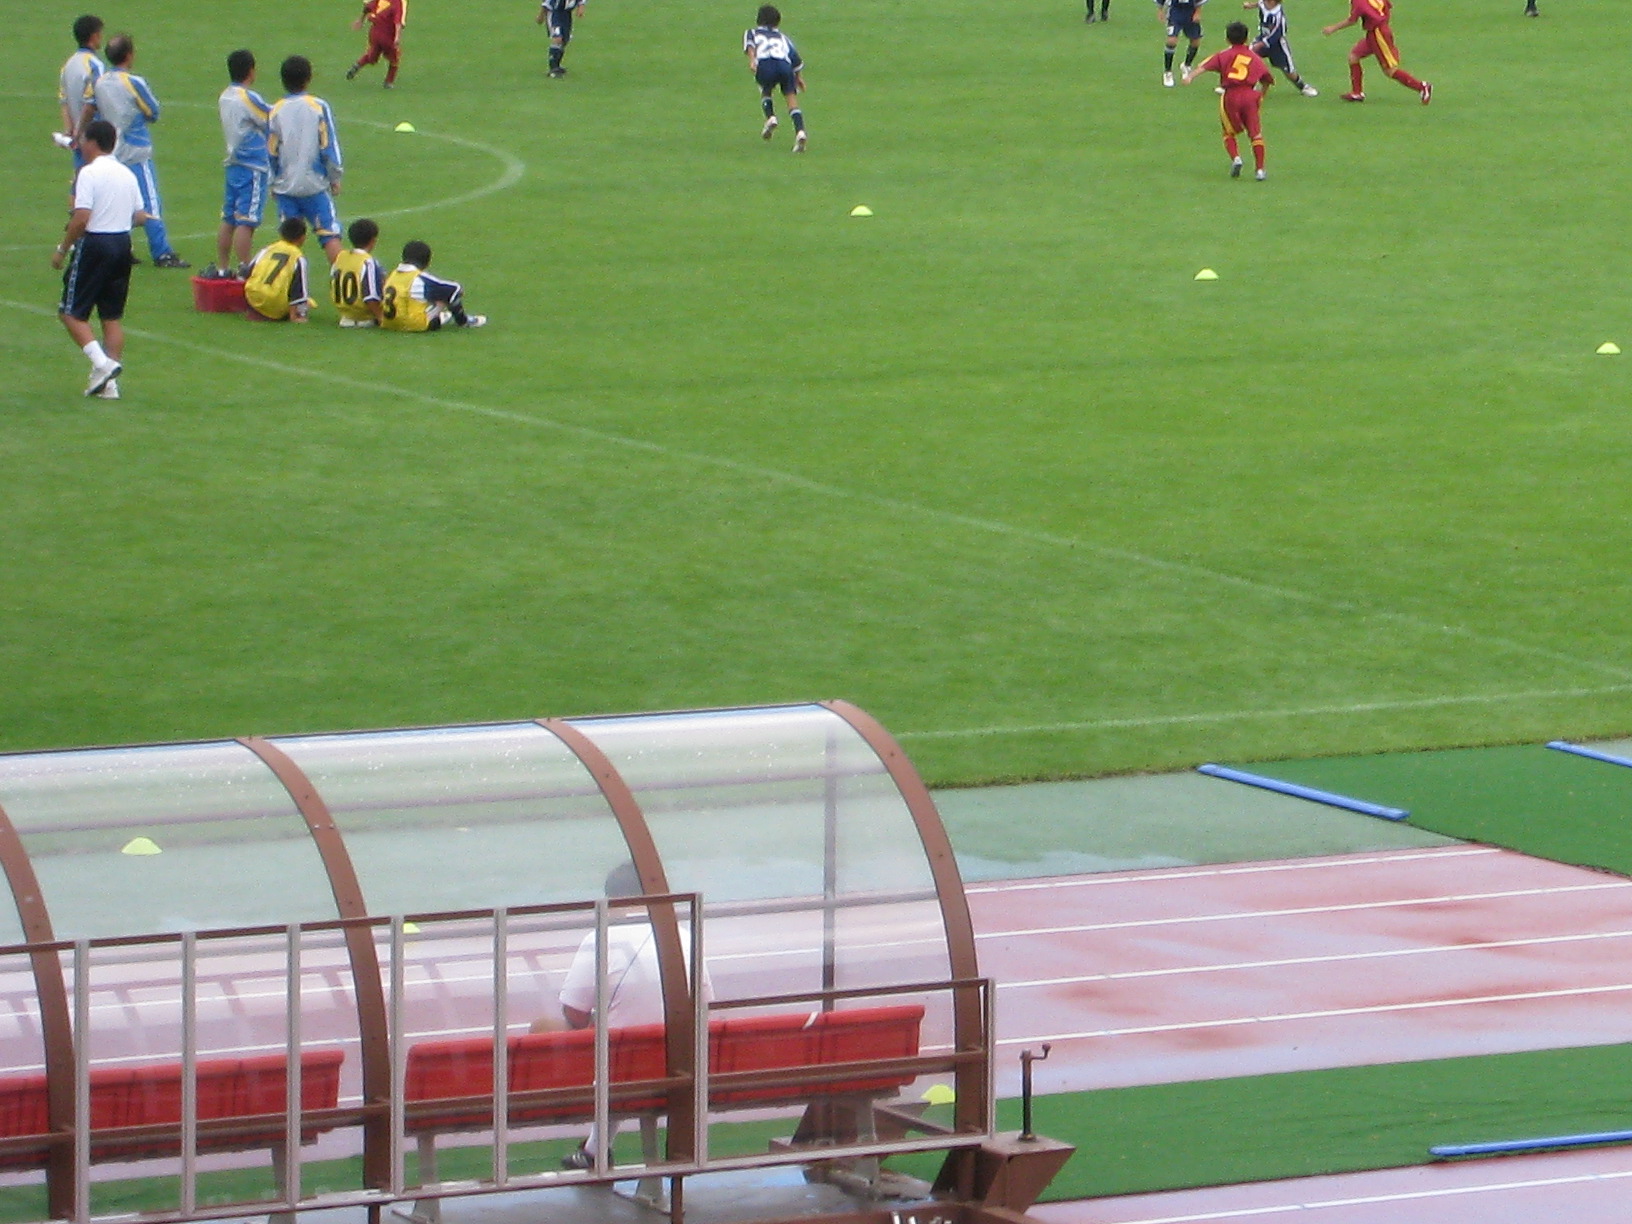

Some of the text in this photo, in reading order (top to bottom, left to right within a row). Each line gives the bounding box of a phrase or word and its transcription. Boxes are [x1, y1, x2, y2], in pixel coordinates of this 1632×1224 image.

[756, 34, 785, 60] 23
[1228, 53, 1253, 82] 5
[264, 252, 291, 285] 7
[333, 268, 359, 306] 10
